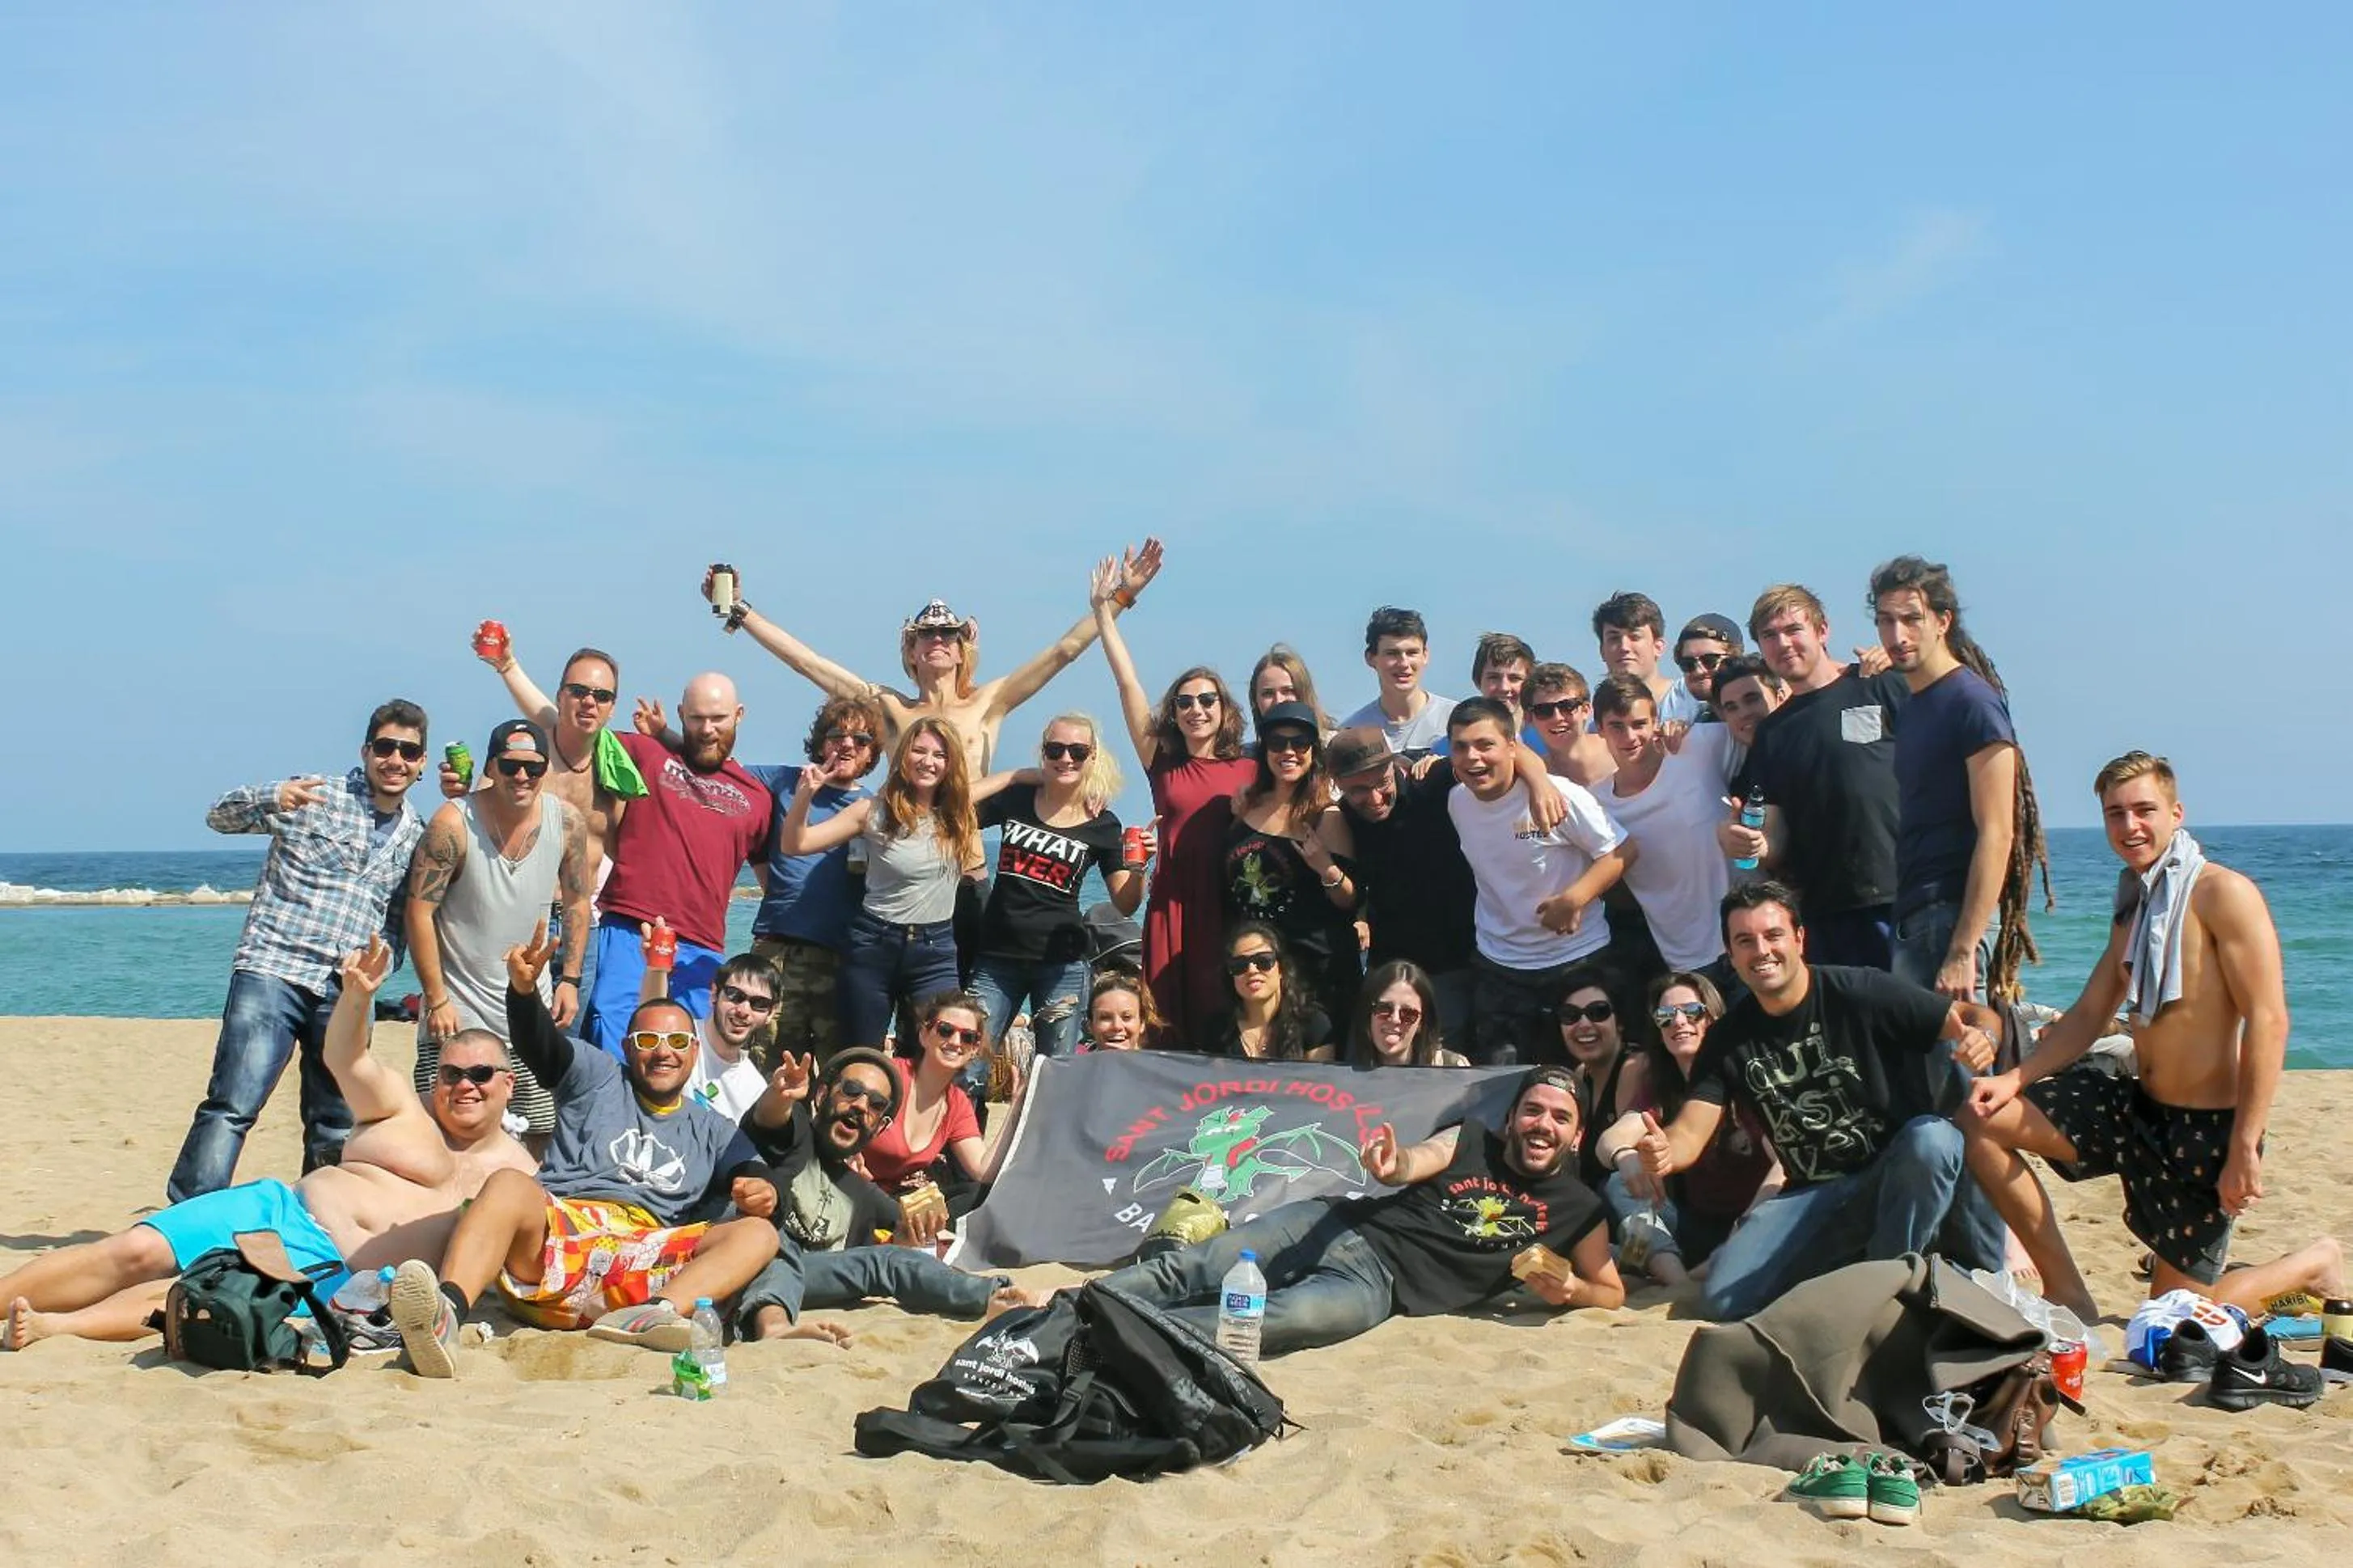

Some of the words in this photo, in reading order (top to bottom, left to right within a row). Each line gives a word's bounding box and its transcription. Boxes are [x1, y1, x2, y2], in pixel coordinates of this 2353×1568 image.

[1003, 822, 1089, 864] WHAT
[1000, 847, 1073, 888] EVER
[1104, 1105, 1170, 1163] SANT
[1179, 1080, 1280, 1112] JORDI
[954, 1359, 978, 1370] sant
[977, 1361, 1006, 1380] jordi
